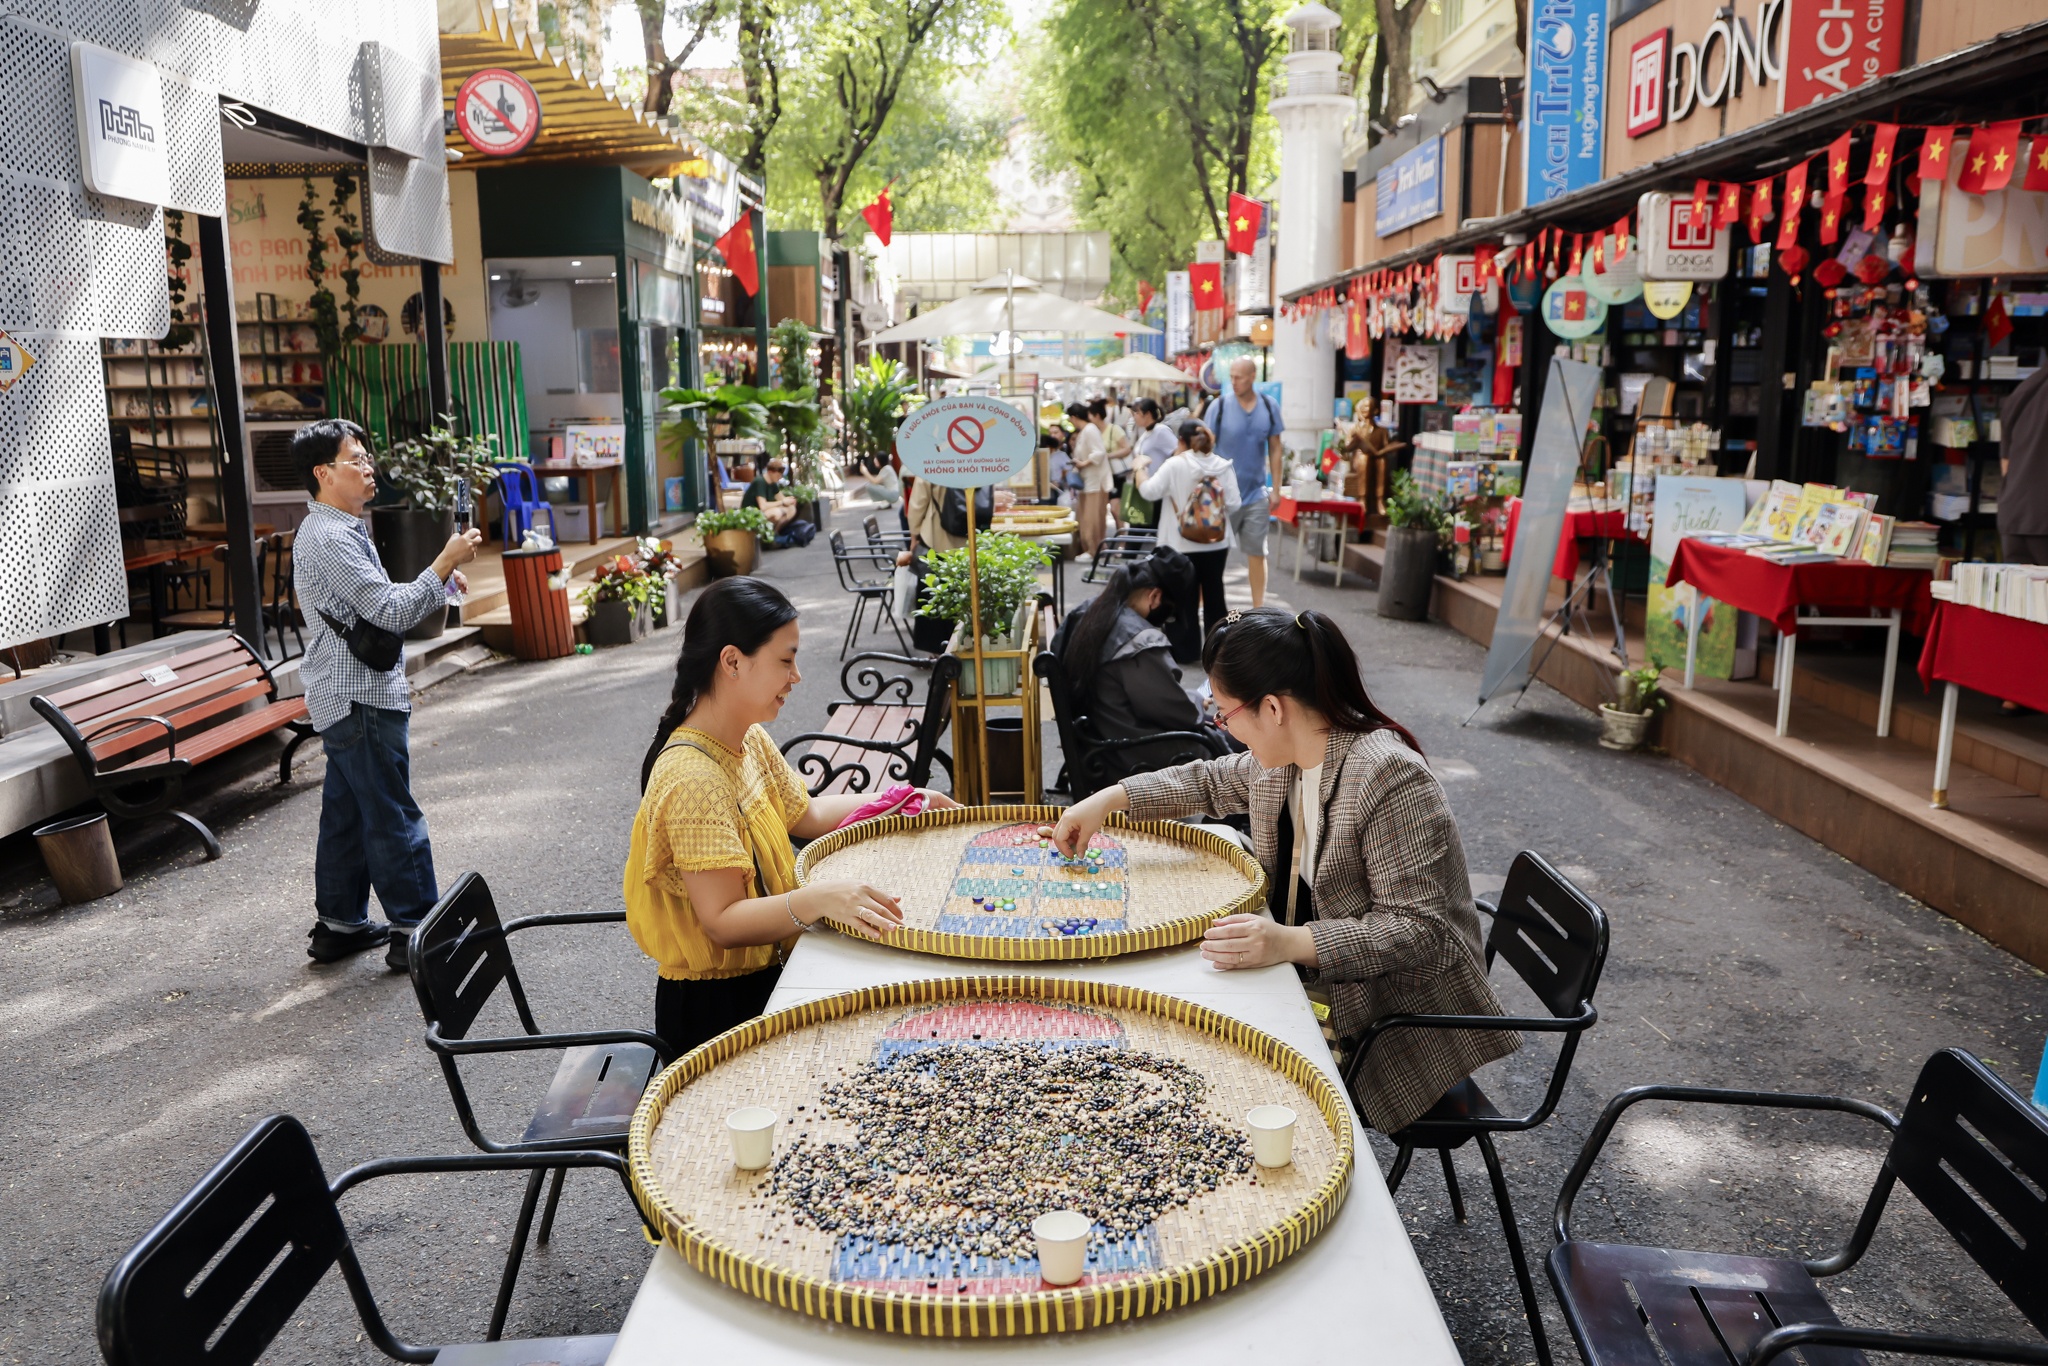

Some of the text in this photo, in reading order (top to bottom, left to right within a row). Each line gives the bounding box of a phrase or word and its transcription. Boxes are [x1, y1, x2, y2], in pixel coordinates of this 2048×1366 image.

[909, 418, 922, 432] SỨC
[924, 462, 1010, 475] KHÔNG KHÓI THUỐC
[1672, 501, 1722, 533] Heidi
